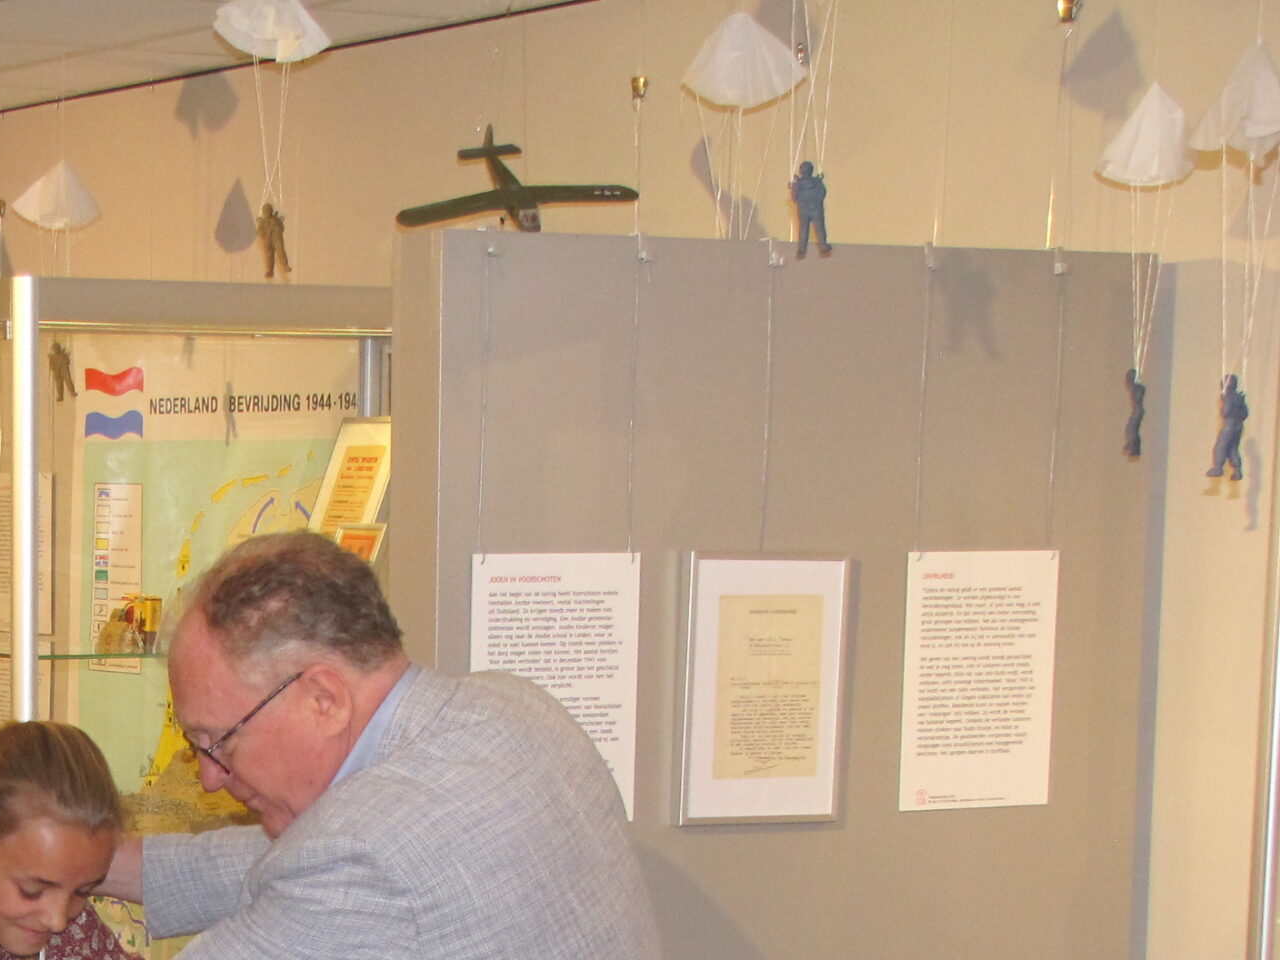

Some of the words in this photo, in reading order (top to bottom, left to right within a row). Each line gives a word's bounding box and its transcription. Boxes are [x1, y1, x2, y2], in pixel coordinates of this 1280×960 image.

[149, 395, 218, 415] NEDERLAND
[229, 393, 301, 413] BEVRIJDING
[305, 392, 357, 411] 1944-194
[518, 575, 562, 583] VOORSCHOTEN
